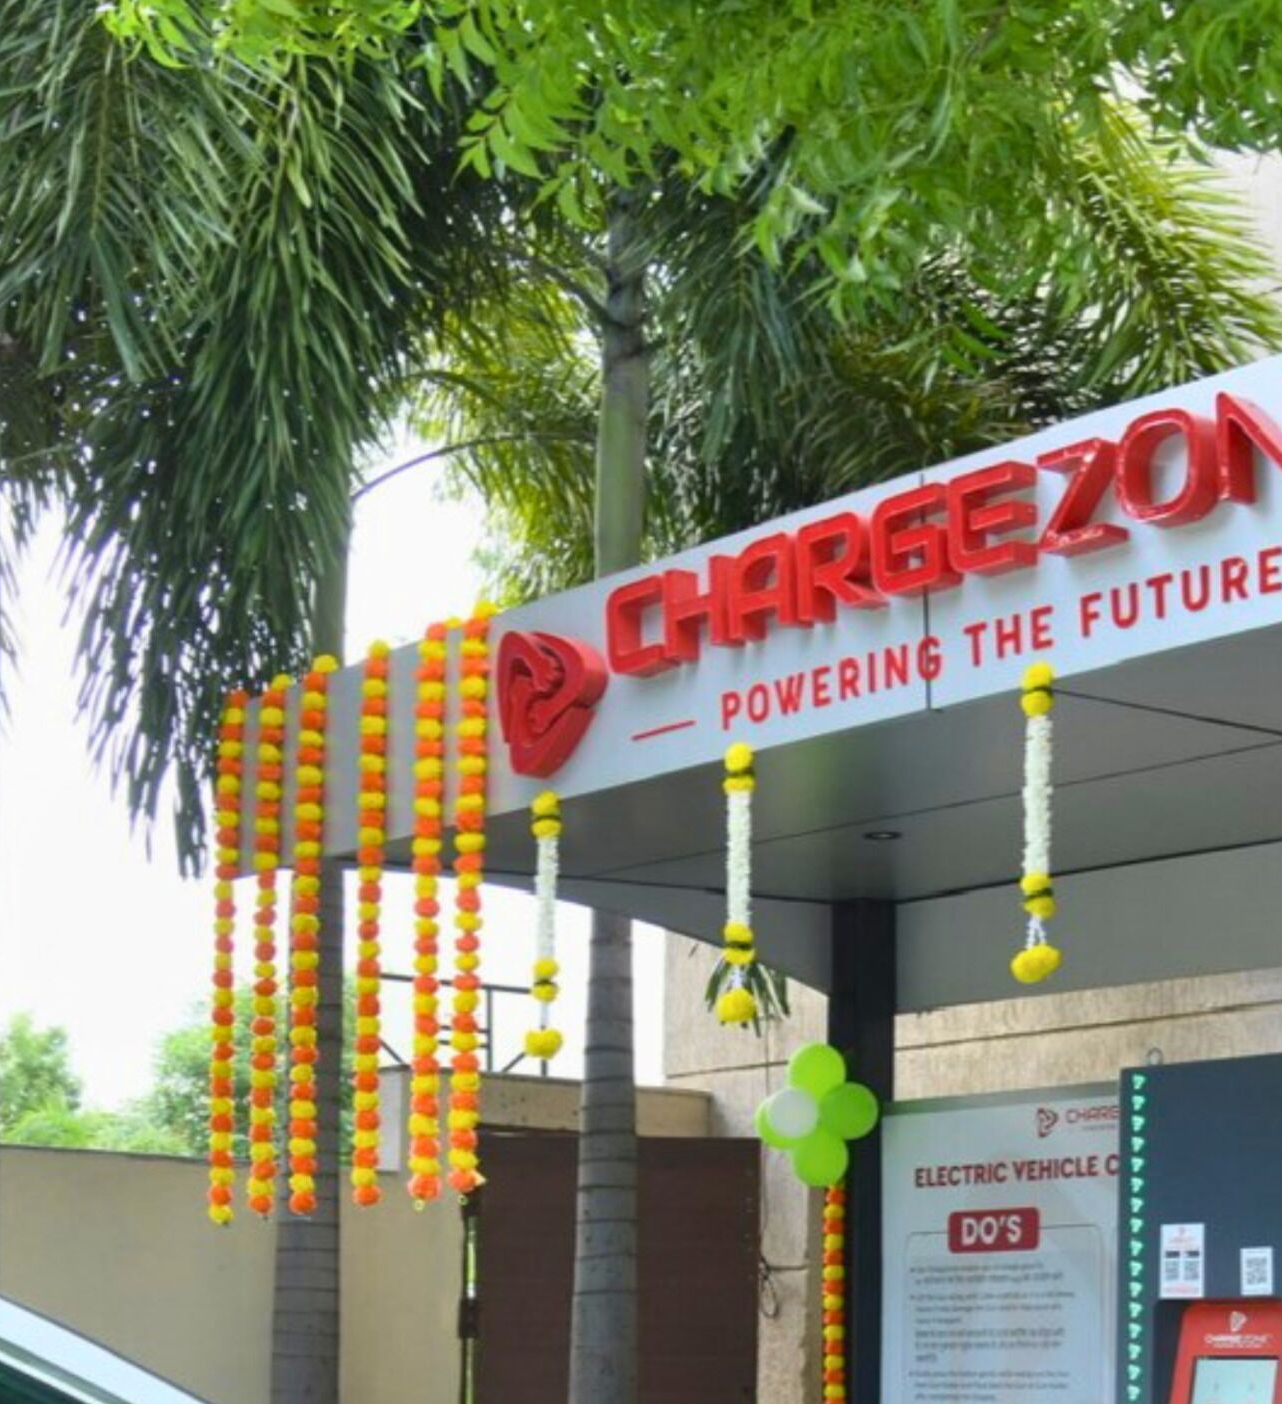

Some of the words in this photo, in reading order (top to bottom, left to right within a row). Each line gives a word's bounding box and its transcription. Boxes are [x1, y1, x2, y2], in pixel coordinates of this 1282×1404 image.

[721, 635, 941, 731] POWERING
[965, 602, 1056, 665] THE
[914, 1163, 1008, 1188] ELECTRIC
[1012, 1155, 1098, 1181] VEHICLE
[961, 1214, 1022, 1246] DO'S
